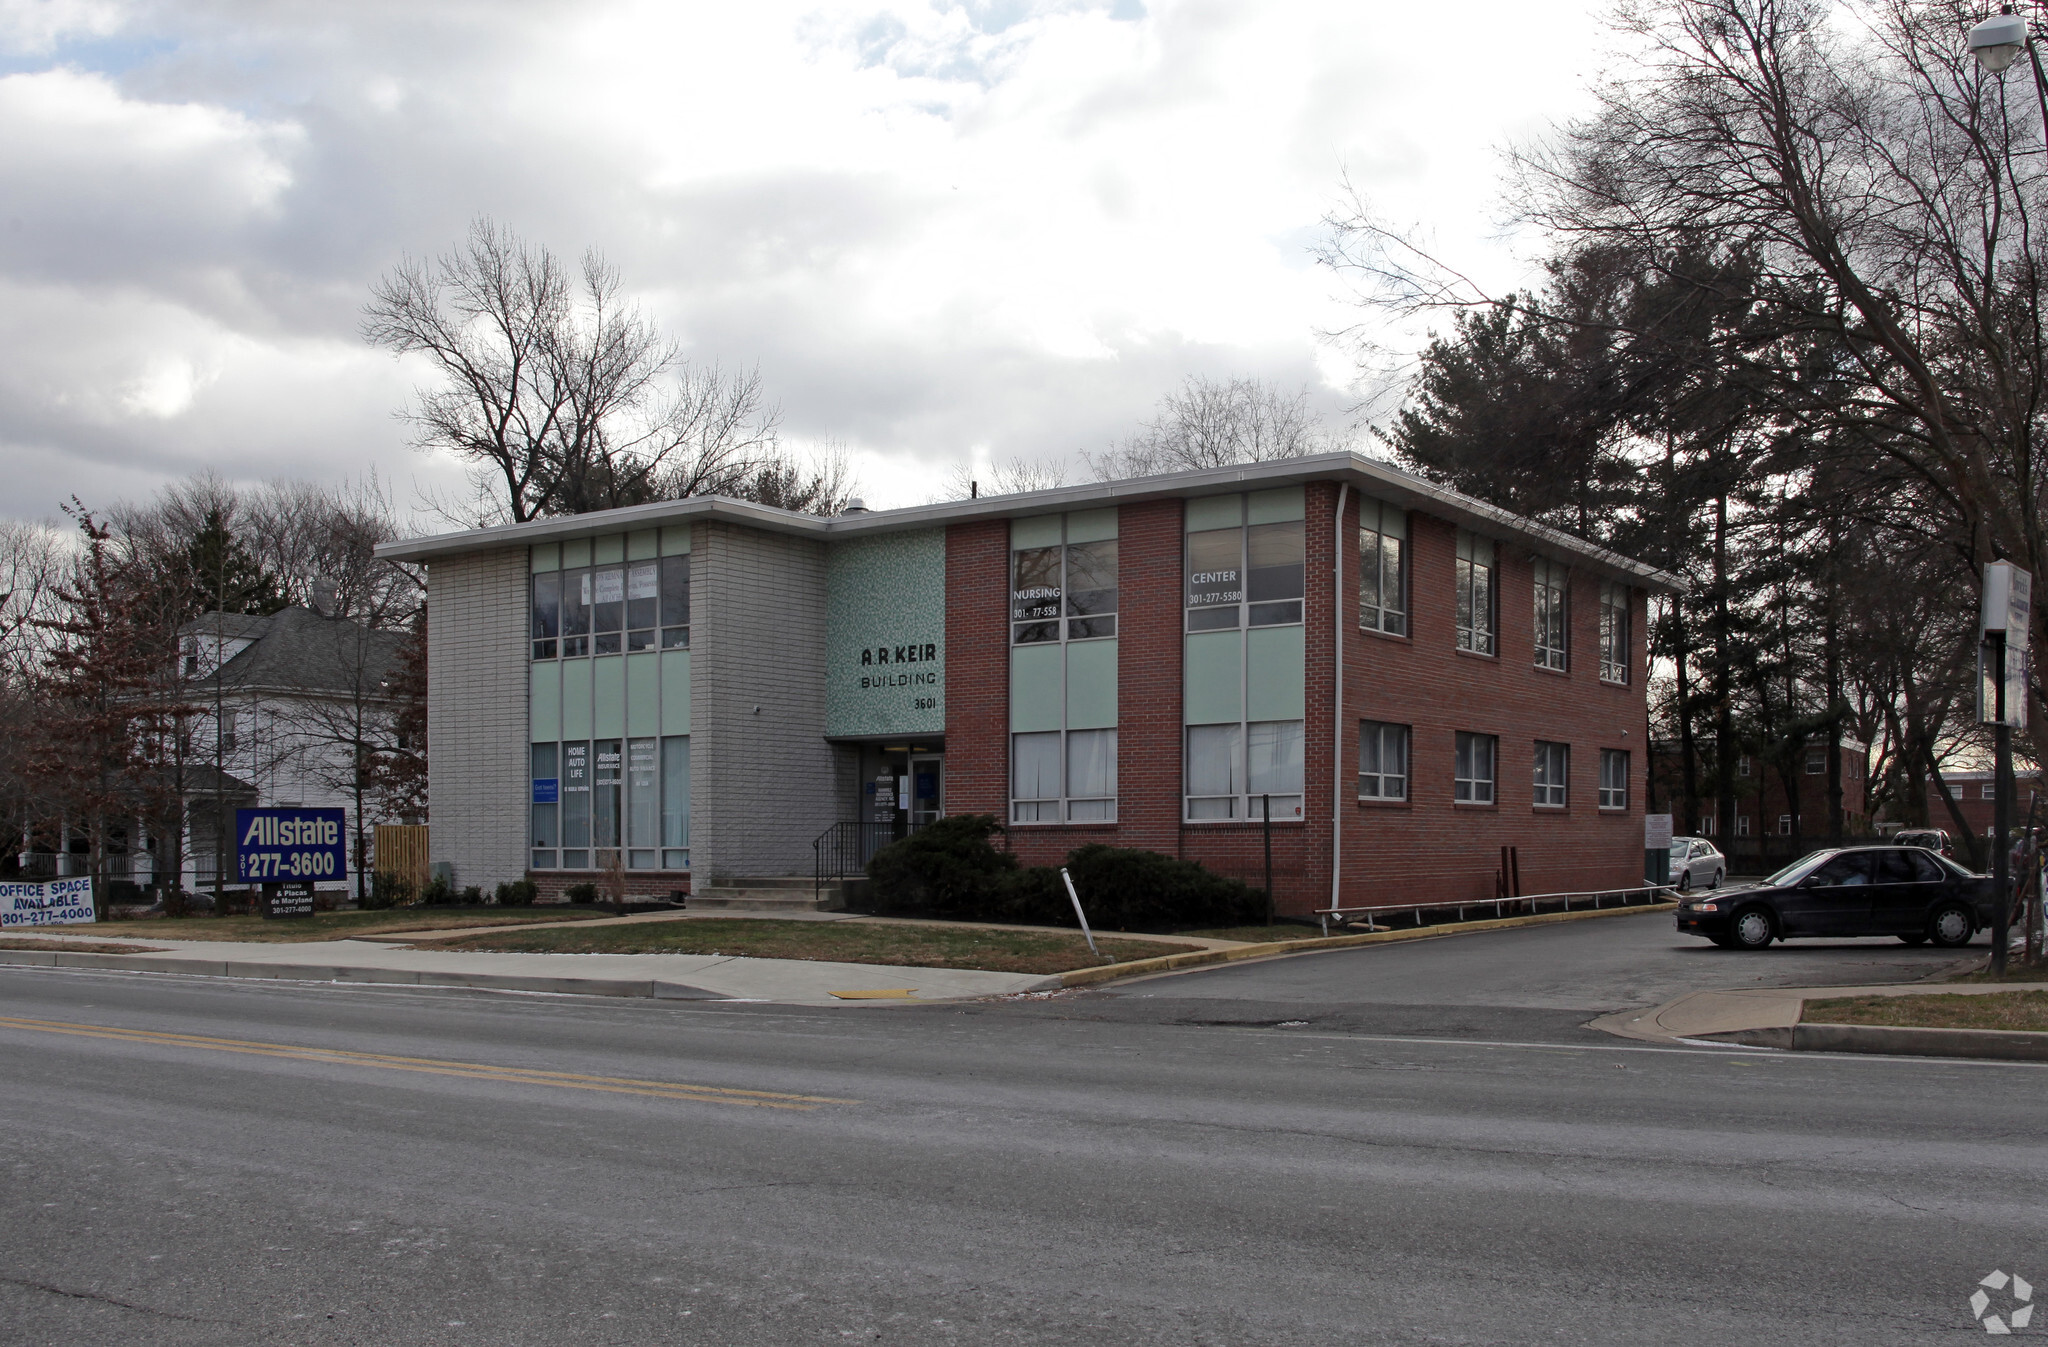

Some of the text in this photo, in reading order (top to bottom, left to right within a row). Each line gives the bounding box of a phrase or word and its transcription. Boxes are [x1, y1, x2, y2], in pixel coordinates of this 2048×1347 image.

[1192, 571, 1237, 584] CENTER
[1013, 587, 1061, 600] NURSING
[1189, 591, 1242, 604] 301-277-5580
[861, 672, 936, 688] BUILDING
[914, 697, 936, 710] 3601
[568, 746, 585, 756] HOME
[597, 752, 621, 762] Allstate
[568, 758, 586, 767] AUTO
[570, 769, 583, 779] LIFE
[242, 816, 338, 846] Allstate
[249, 851, 335, 878] 277-3600
[0, 879, 90, 897] OFFICE SPACE
[284, 889, 308, 897] Placas
[14, 894, 80, 910] AVAILABLE
[281, 896, 313, 905] Maryland
[2, 907, 93, 925] 301-277-4000
